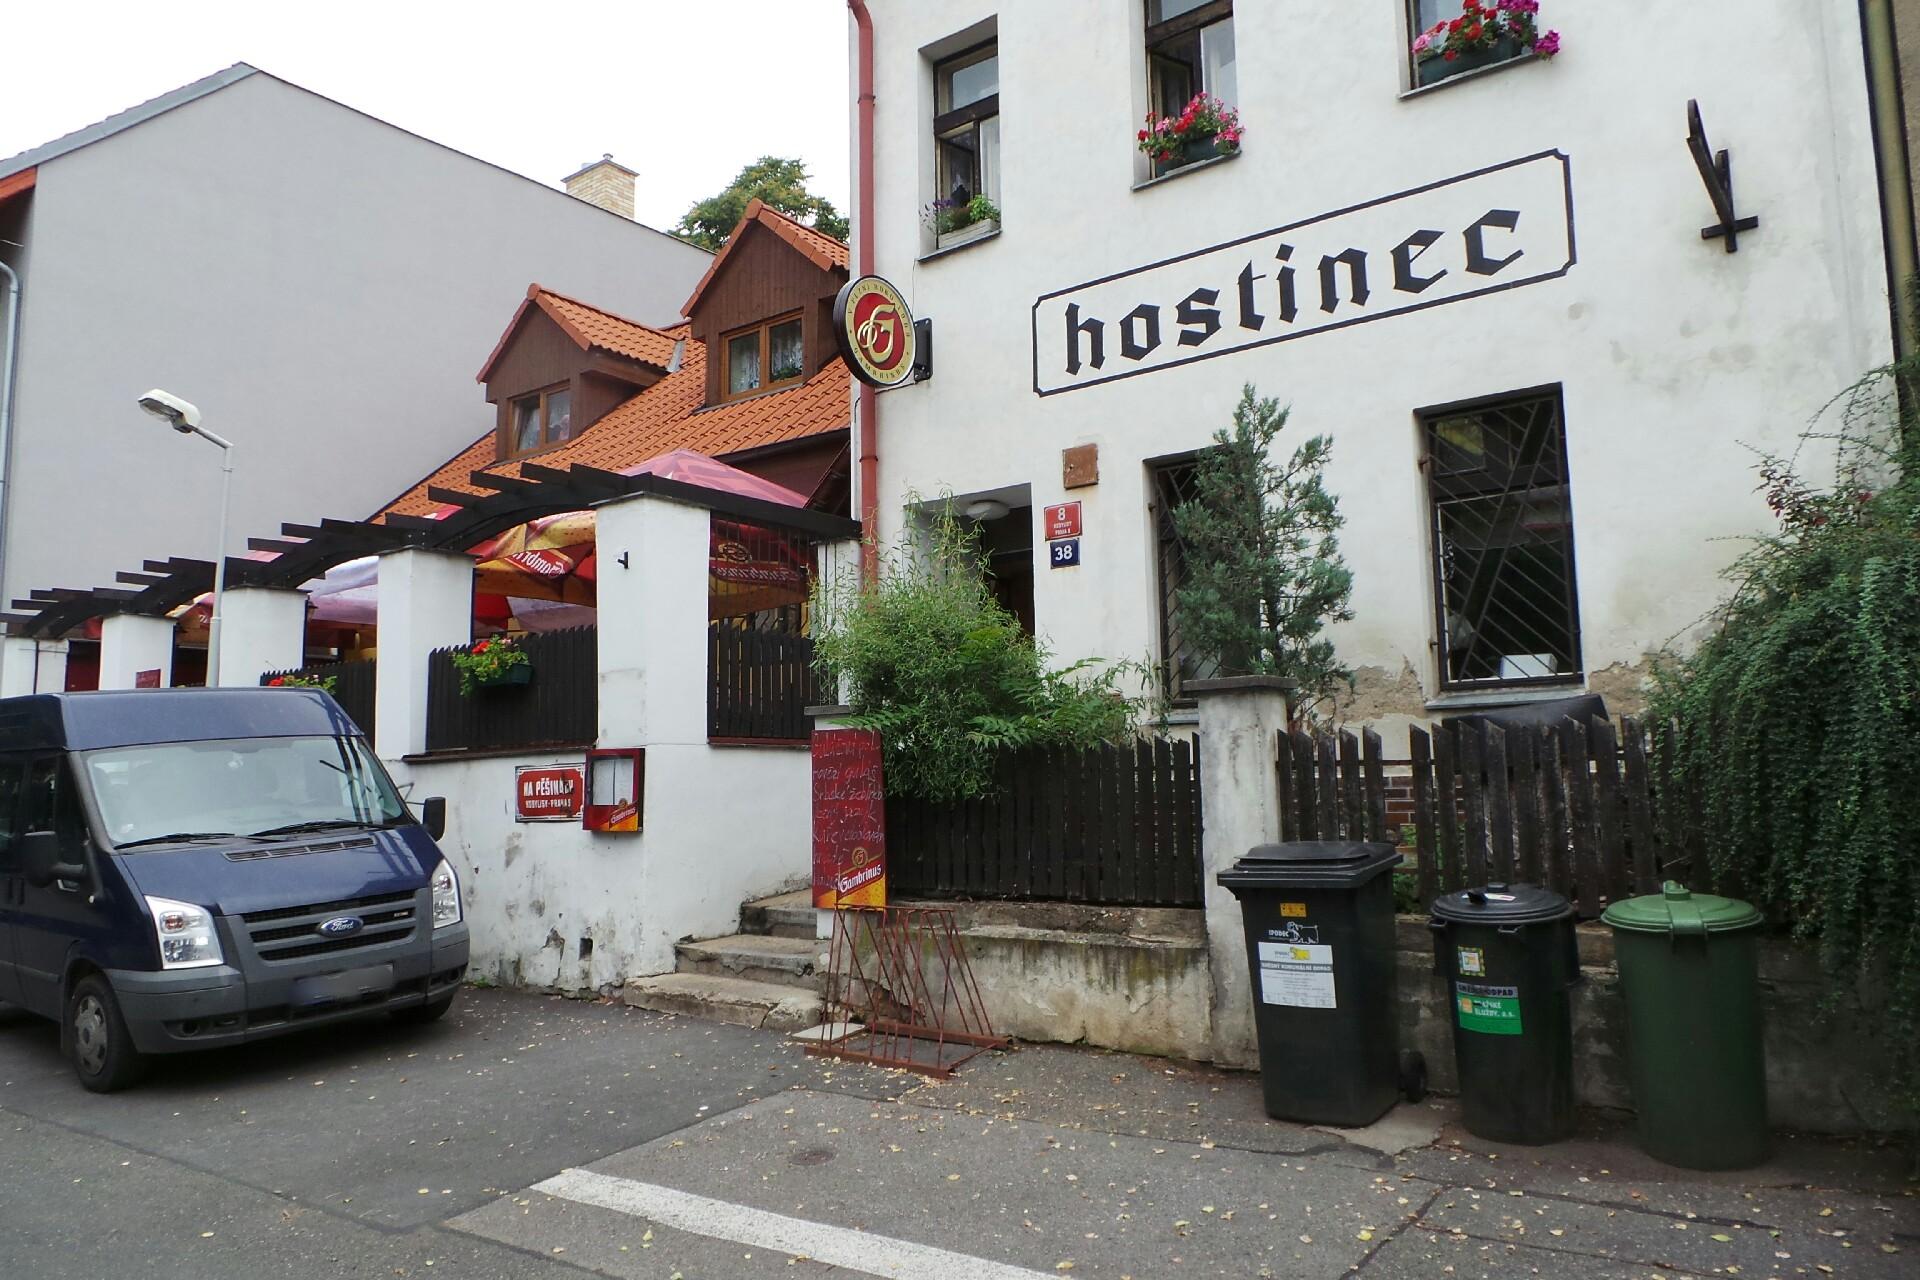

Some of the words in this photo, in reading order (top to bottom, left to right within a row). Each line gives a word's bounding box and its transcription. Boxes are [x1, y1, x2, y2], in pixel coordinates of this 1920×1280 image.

[1065, 208, 1524, 375] hostinec
[1057, 507, 1066, 521] 8
[1055, 544, 1073, 560] 38
[523, 781, 533, 796] NA
[839, 863, 882, 893] Gambrinus
[330, 919, 354, 933] Ford
